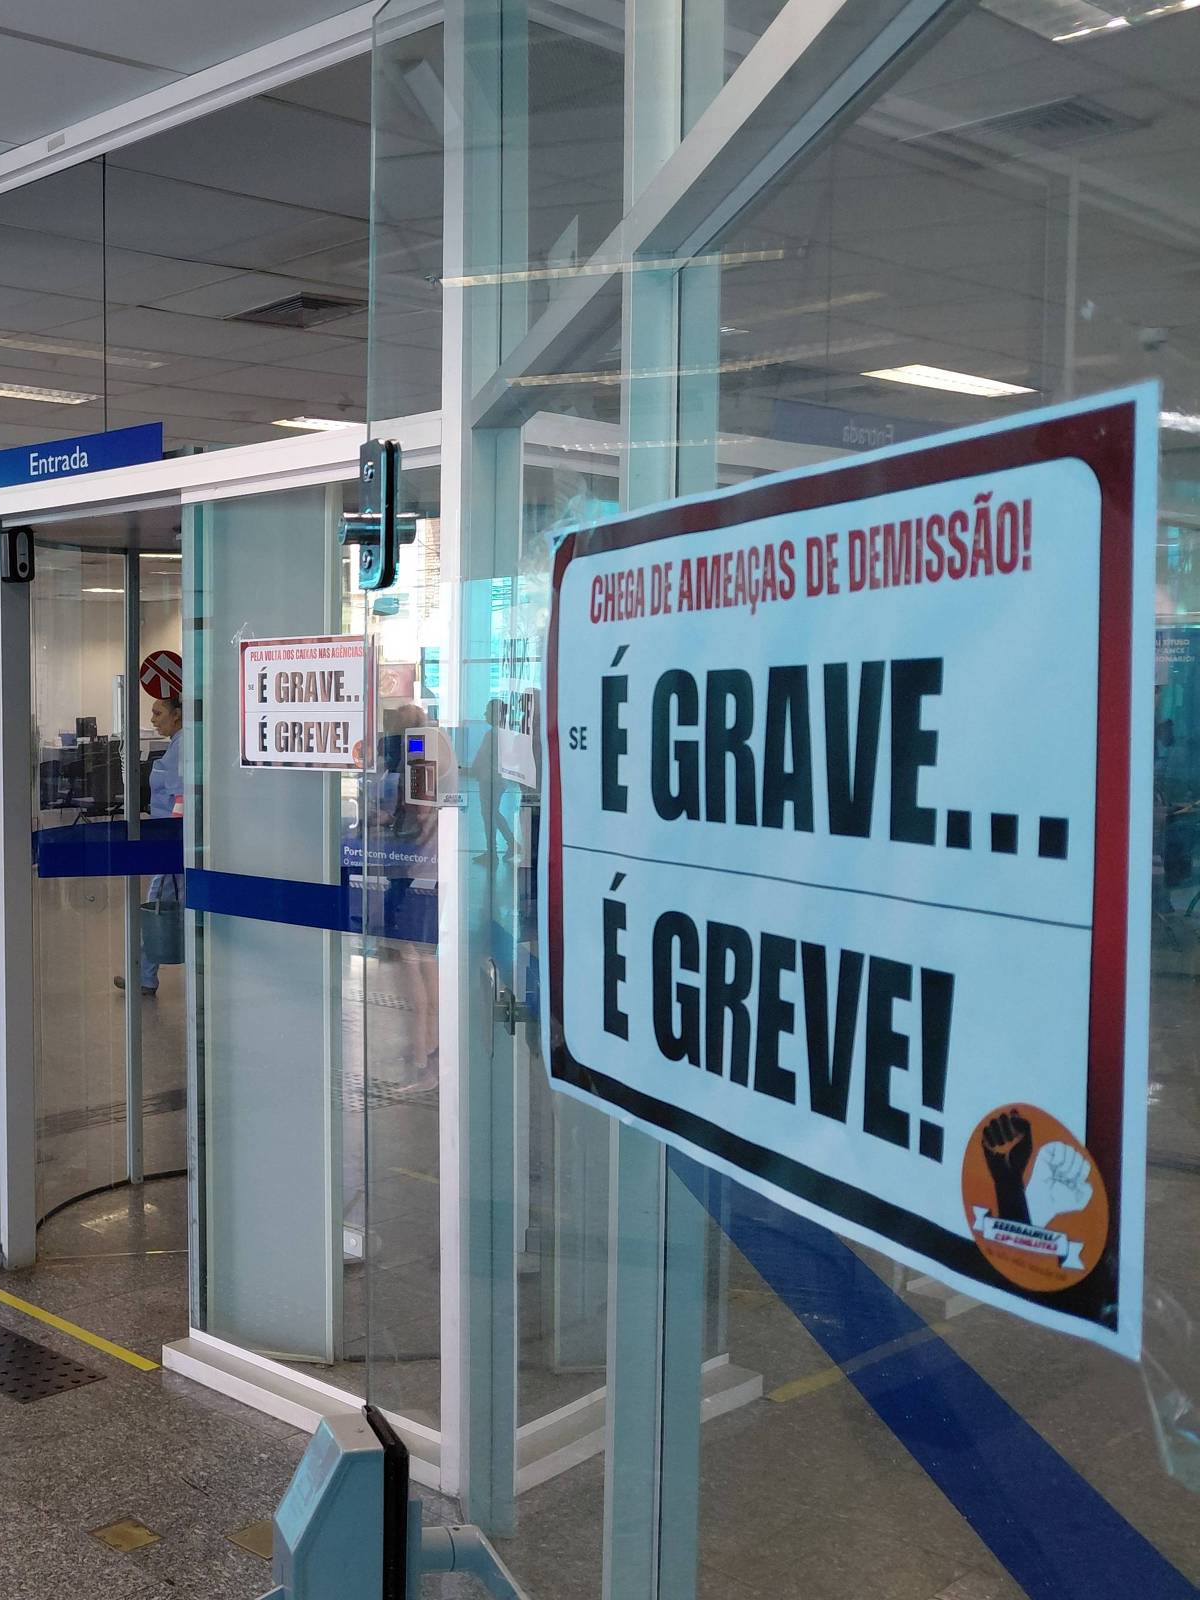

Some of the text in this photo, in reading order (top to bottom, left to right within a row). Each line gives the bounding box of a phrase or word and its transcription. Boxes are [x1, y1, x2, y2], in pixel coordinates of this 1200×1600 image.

[29, 446, 89, 476] Entrada
[590, 490, 1032, 624] CHEGA DE AMEAÇAS DE DEMISSÃO!
[257, 666, 268, 703] É
[258, 715, 350, 753] É GREVE!
[569, 645, 1069, 860] SE É GRAVE...
[343, 846, 368, 856] Port
[368, 851, 387, 859] com
[389, 851, 428, 863] detector
[602, 872, 956, 1165] É GREVE!
